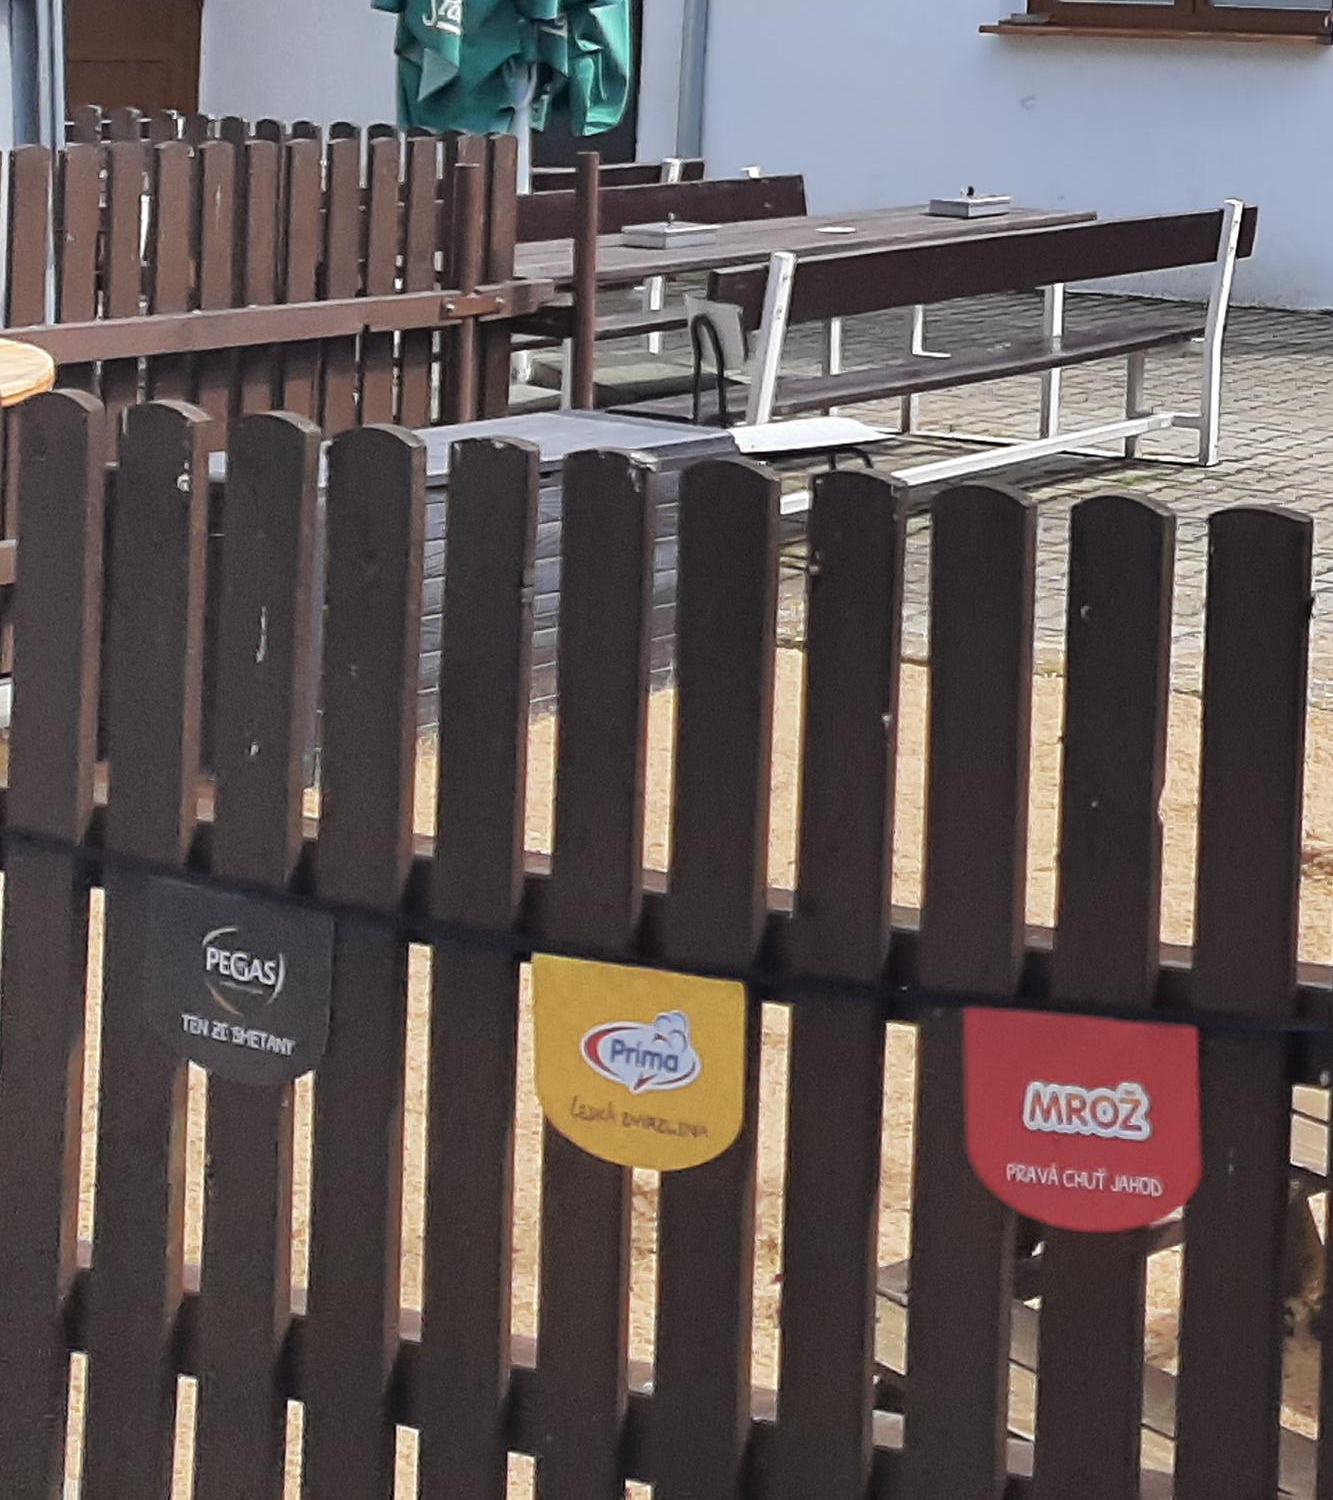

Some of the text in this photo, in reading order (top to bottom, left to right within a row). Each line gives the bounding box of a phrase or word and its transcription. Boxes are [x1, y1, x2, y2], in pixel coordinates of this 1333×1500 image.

[205, 946, 277, 986] PEGAS
[610, 1038, 680, 1073] Prima
[1024, 1082, 1150, 1140] MROŽ
[1005, 1162, 1164, 1198] PRAVÁ CHUŤ JAHOD
